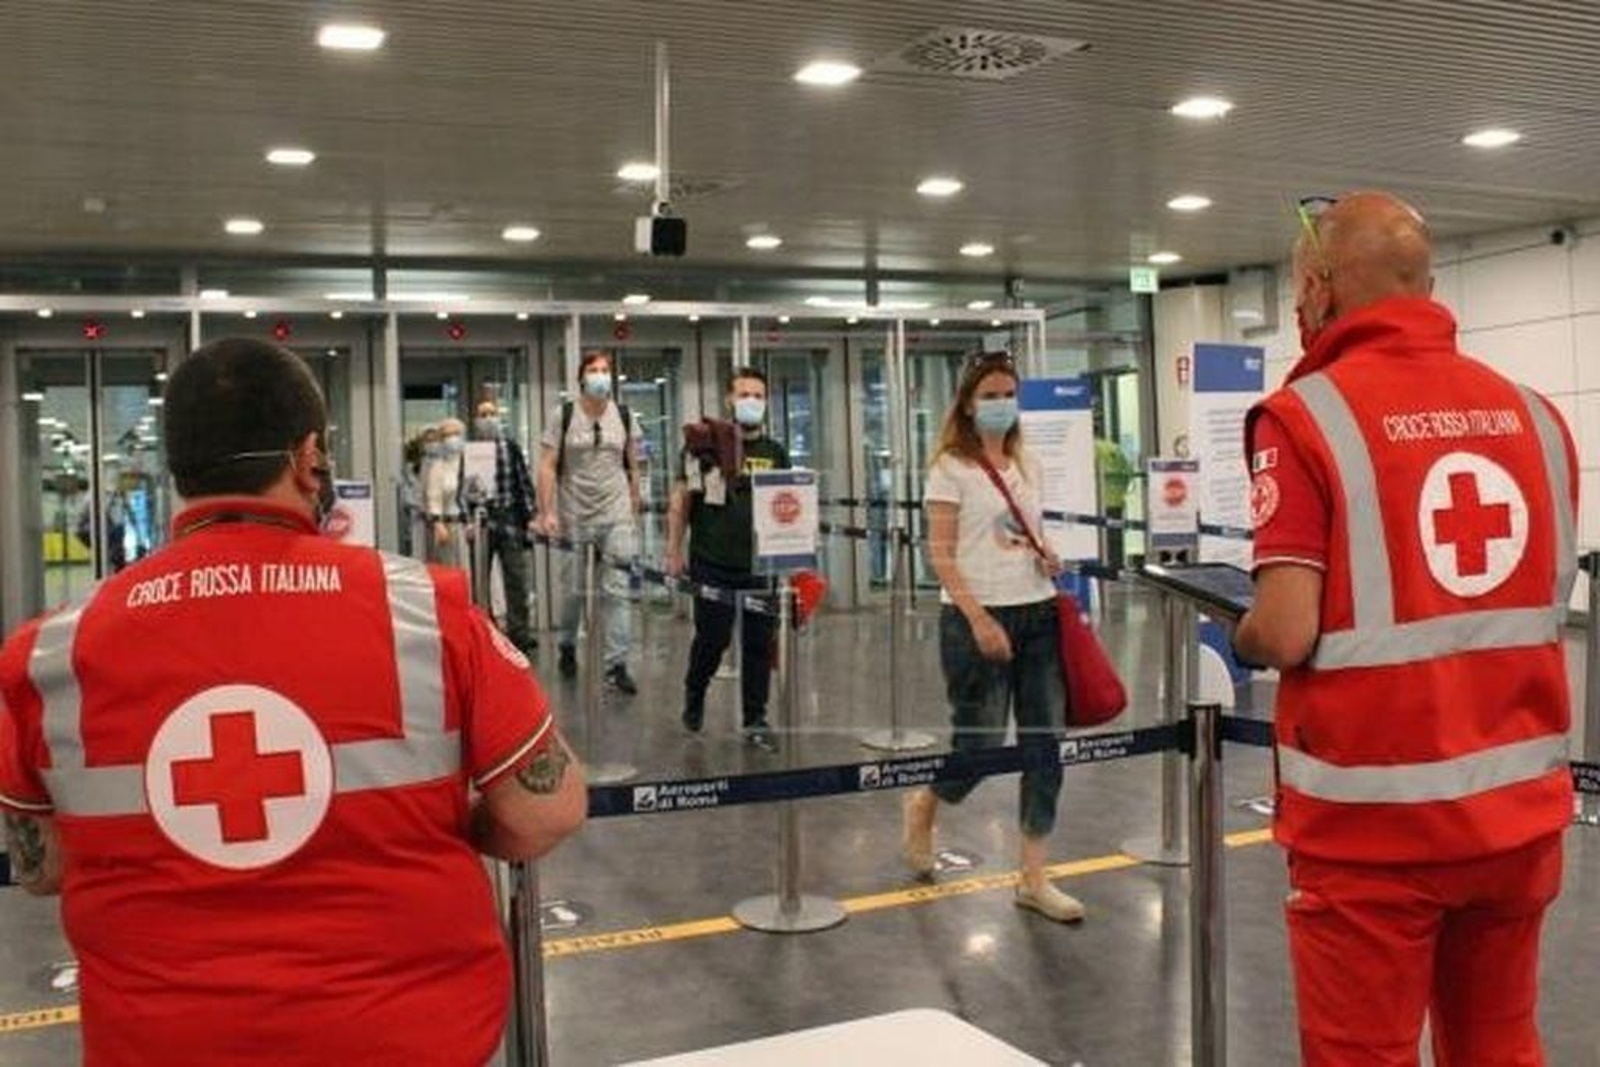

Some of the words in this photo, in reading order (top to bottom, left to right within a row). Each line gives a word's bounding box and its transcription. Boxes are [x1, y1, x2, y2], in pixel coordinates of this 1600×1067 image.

[1383, 412, 1432, 441] CROCE
[1429, 410, 1469, 437] ROSSA
[1468, 408, 1523, 436] ITALIANA
[127, 572, 183, 607] CROCE
[190, 564, 252, 598] ROSSA
[261, 563, 341, 592] ITALIANA
[659, 780, 729, 796] Aeroporti
[676, 793, 719, 807] Roma
